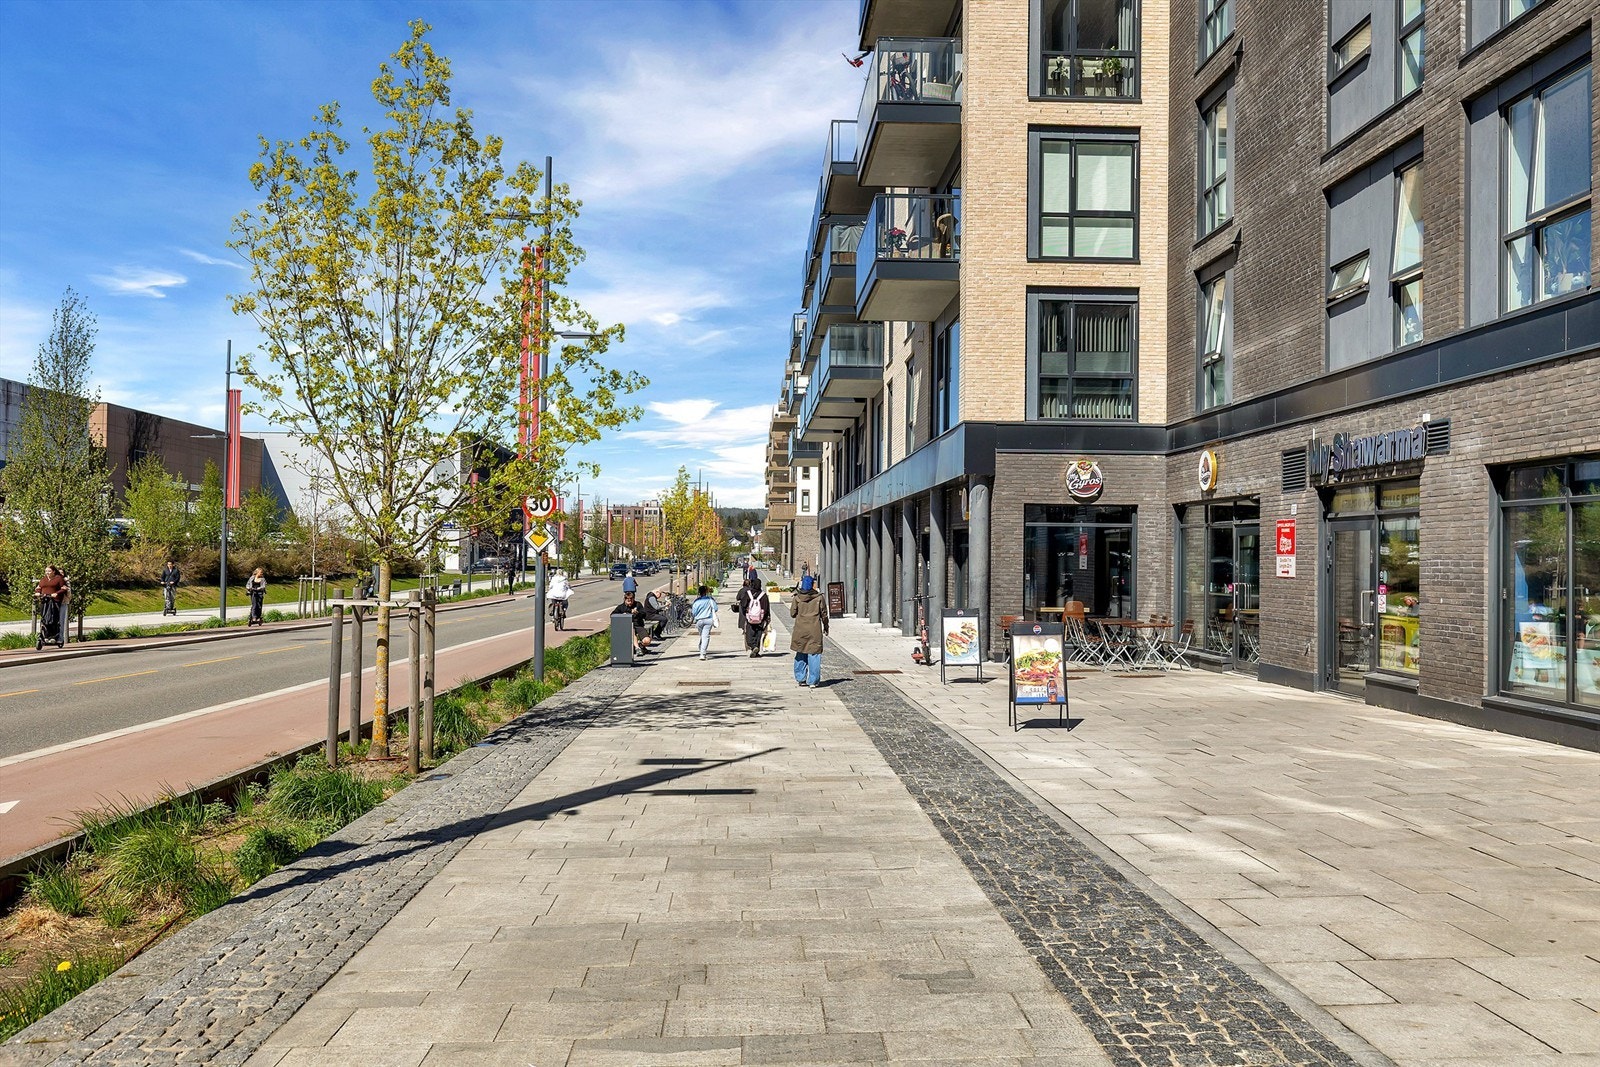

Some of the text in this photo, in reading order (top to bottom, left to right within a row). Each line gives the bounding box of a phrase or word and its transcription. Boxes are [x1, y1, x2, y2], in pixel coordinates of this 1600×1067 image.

[1309, 426, 1427, 485] My Shawarma
[1069, 477, 1100, 489] Gyros
[529, 495, 550, 511] 30
